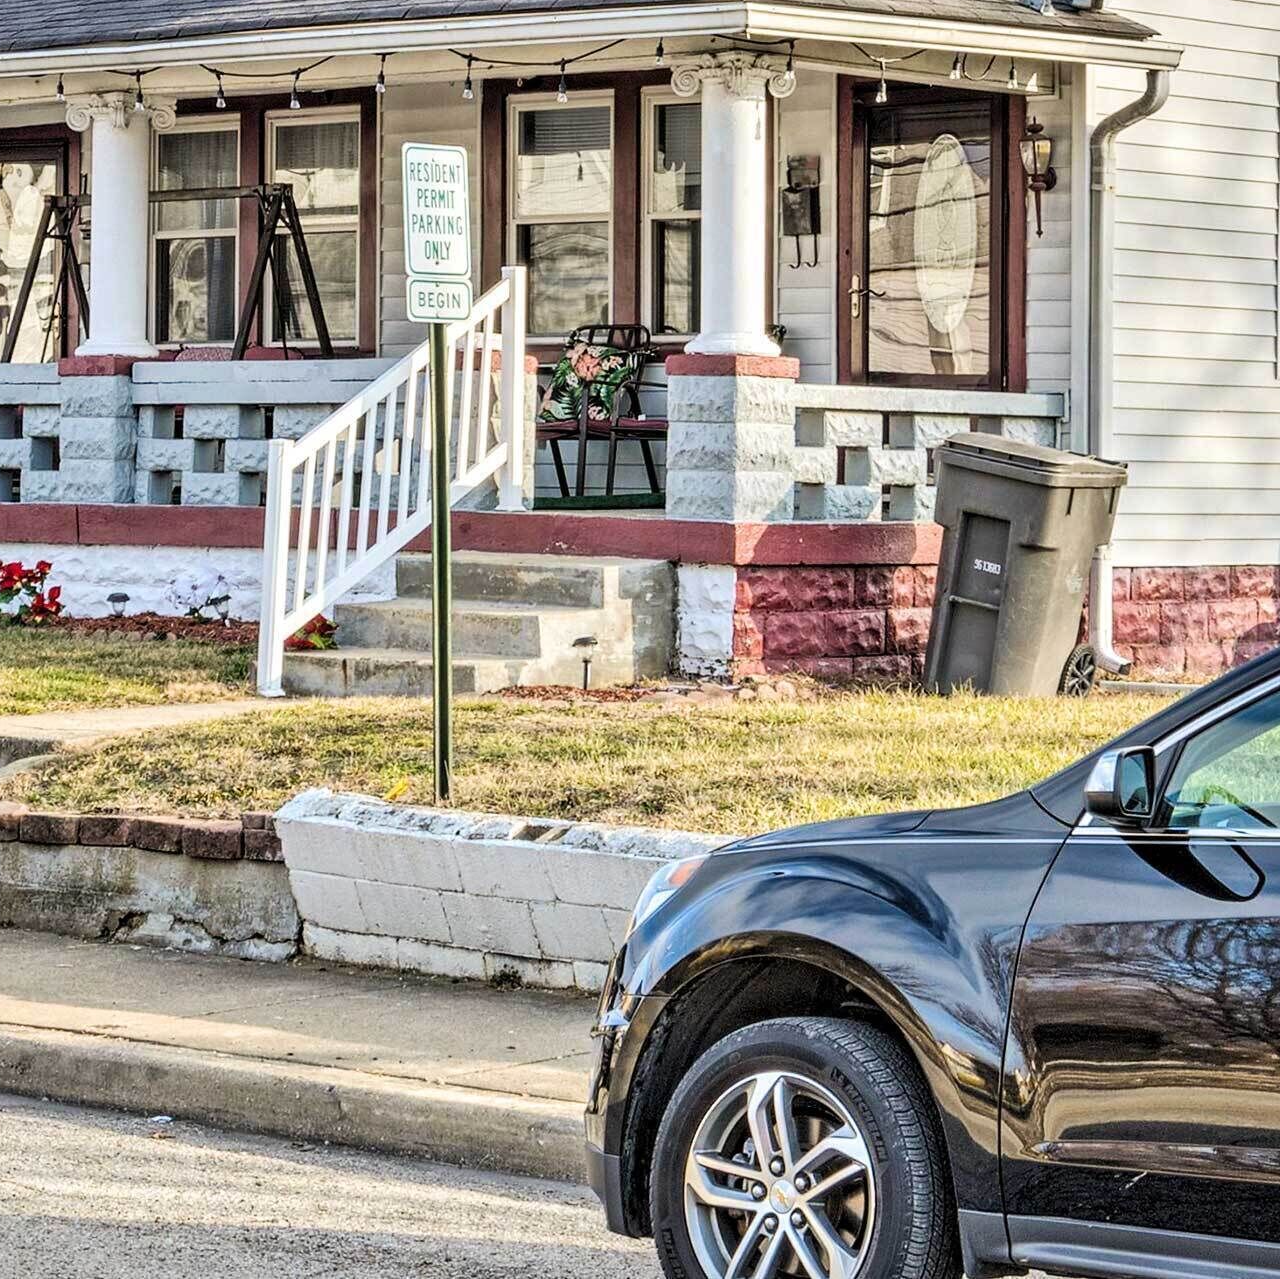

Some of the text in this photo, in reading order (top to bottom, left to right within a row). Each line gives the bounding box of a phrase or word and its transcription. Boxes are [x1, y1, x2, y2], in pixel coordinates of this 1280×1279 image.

[409, 161, 461, 184] RESIDENT
[416, 188, 456, 209] PERMIT
[412, 213, 463, 236] PARKING
[424, 240, 452, 261] ONLY
[418, 291, 462, 309] BEGIN
